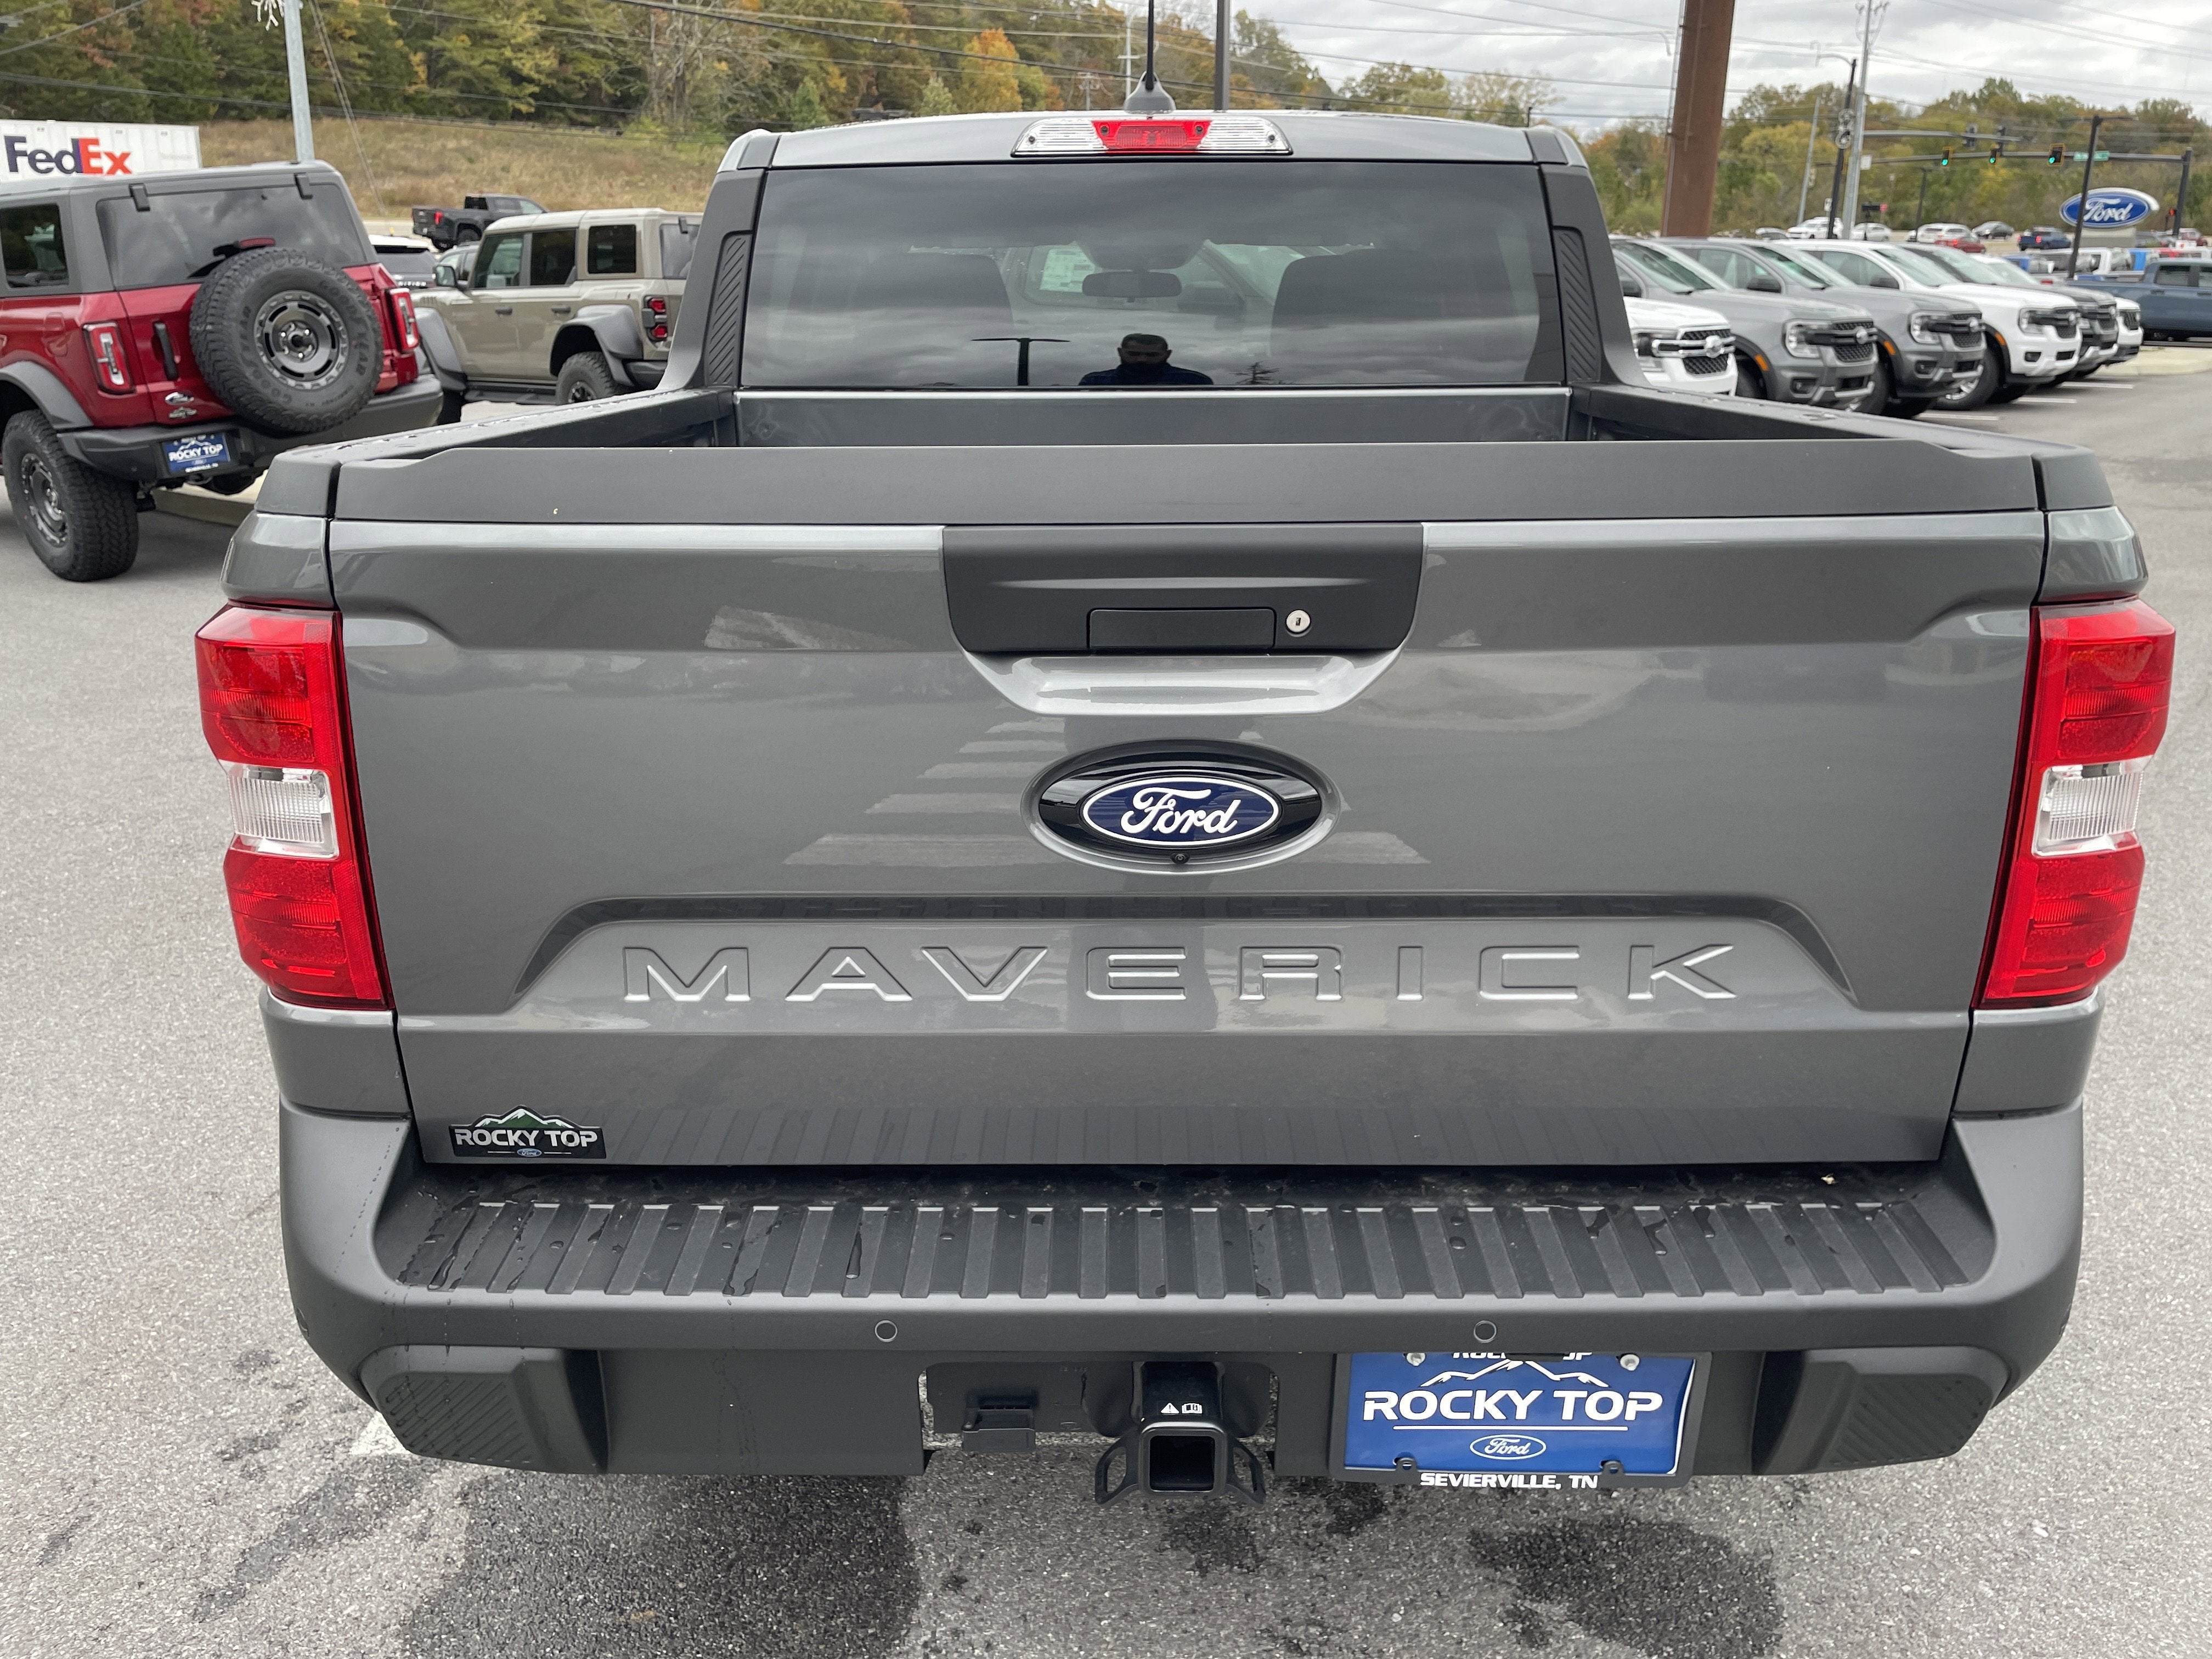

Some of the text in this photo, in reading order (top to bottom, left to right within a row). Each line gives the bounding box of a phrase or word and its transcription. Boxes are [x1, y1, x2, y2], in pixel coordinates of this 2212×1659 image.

[4, 135, 132, 174] FedEx
[2083, 198, 2134, 222] Ford
[168, 443, 223, 461] ROCKY TOP
[1120, 787, 1242, 834] Ford
[623, 944, 1737, 1002] MAVERICK
[454, 1128, 598, 1147] ROCKY TOP
[1363, 1390, 1663, 1421] ROCKY TOP
[1484, 1437, 1531, 1455] Ford
[1420, 1472, 1599, 1490] SEVIERVILLE, TN
